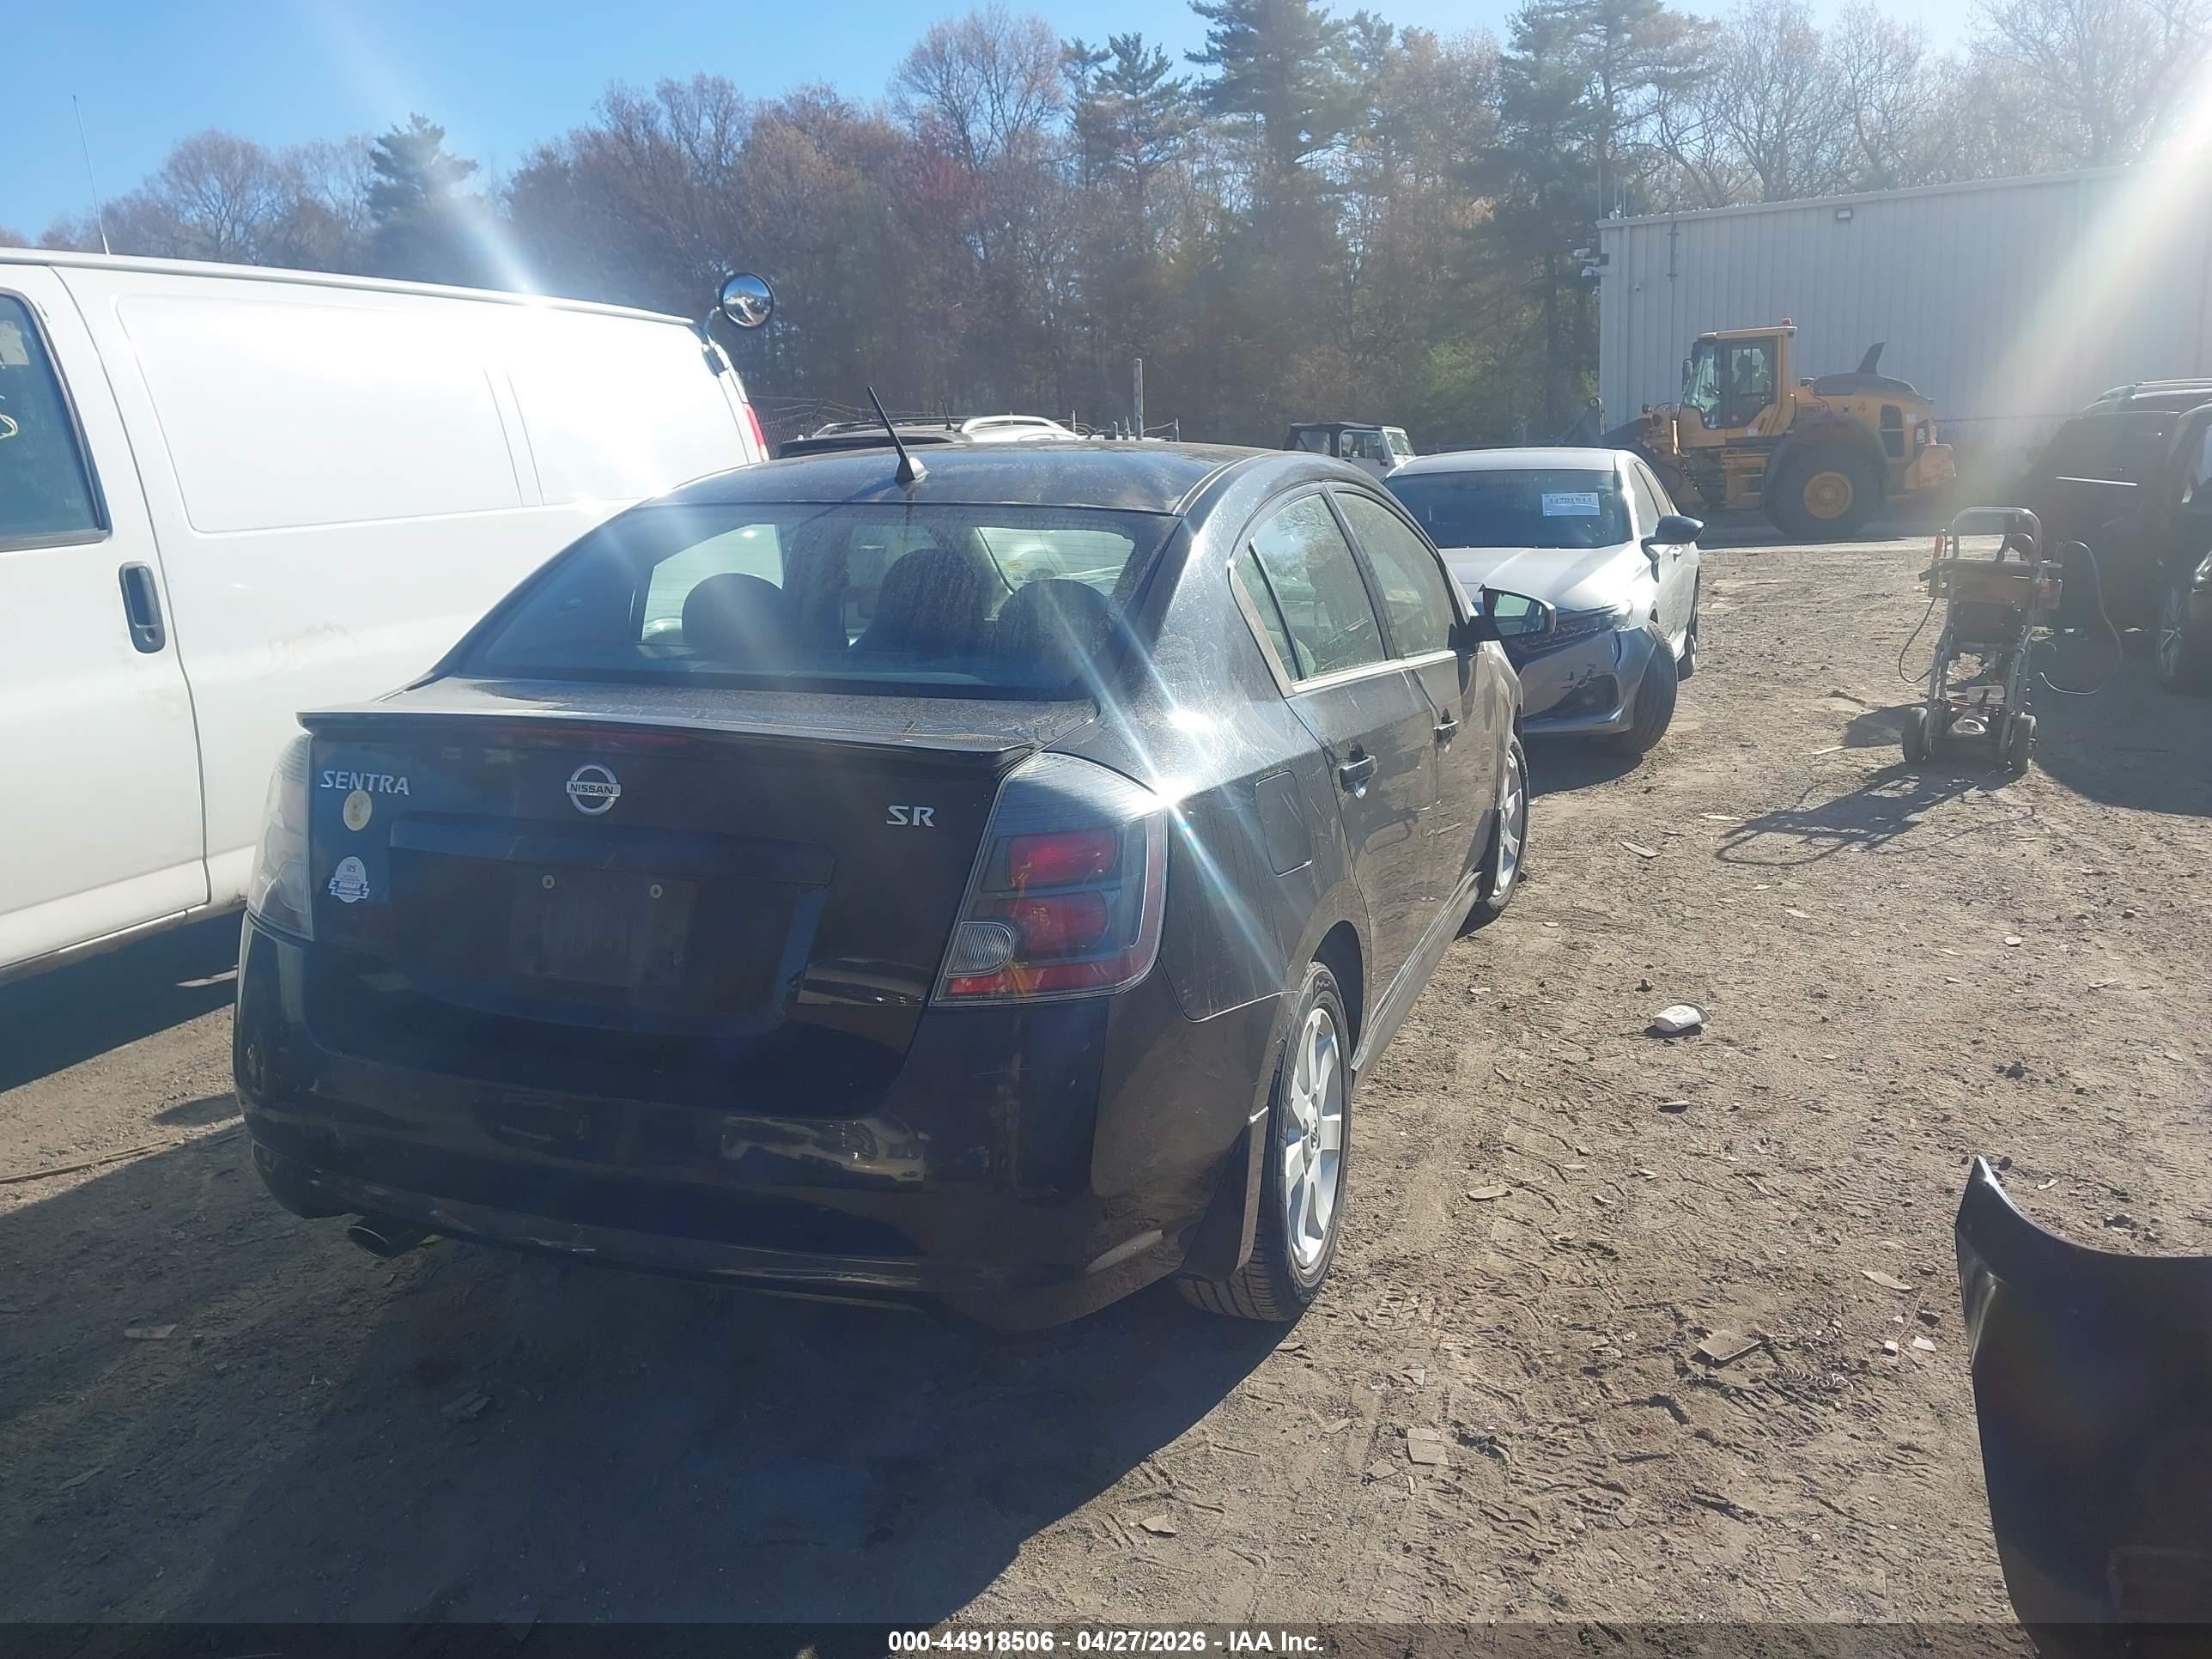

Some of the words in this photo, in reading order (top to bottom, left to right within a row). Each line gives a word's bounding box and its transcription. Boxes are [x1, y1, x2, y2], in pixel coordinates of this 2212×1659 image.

[320, 770, 410, 796] SENTRA
[570, 783, 613, 794] NISSAN
[886, 805, 935, 827] SR
